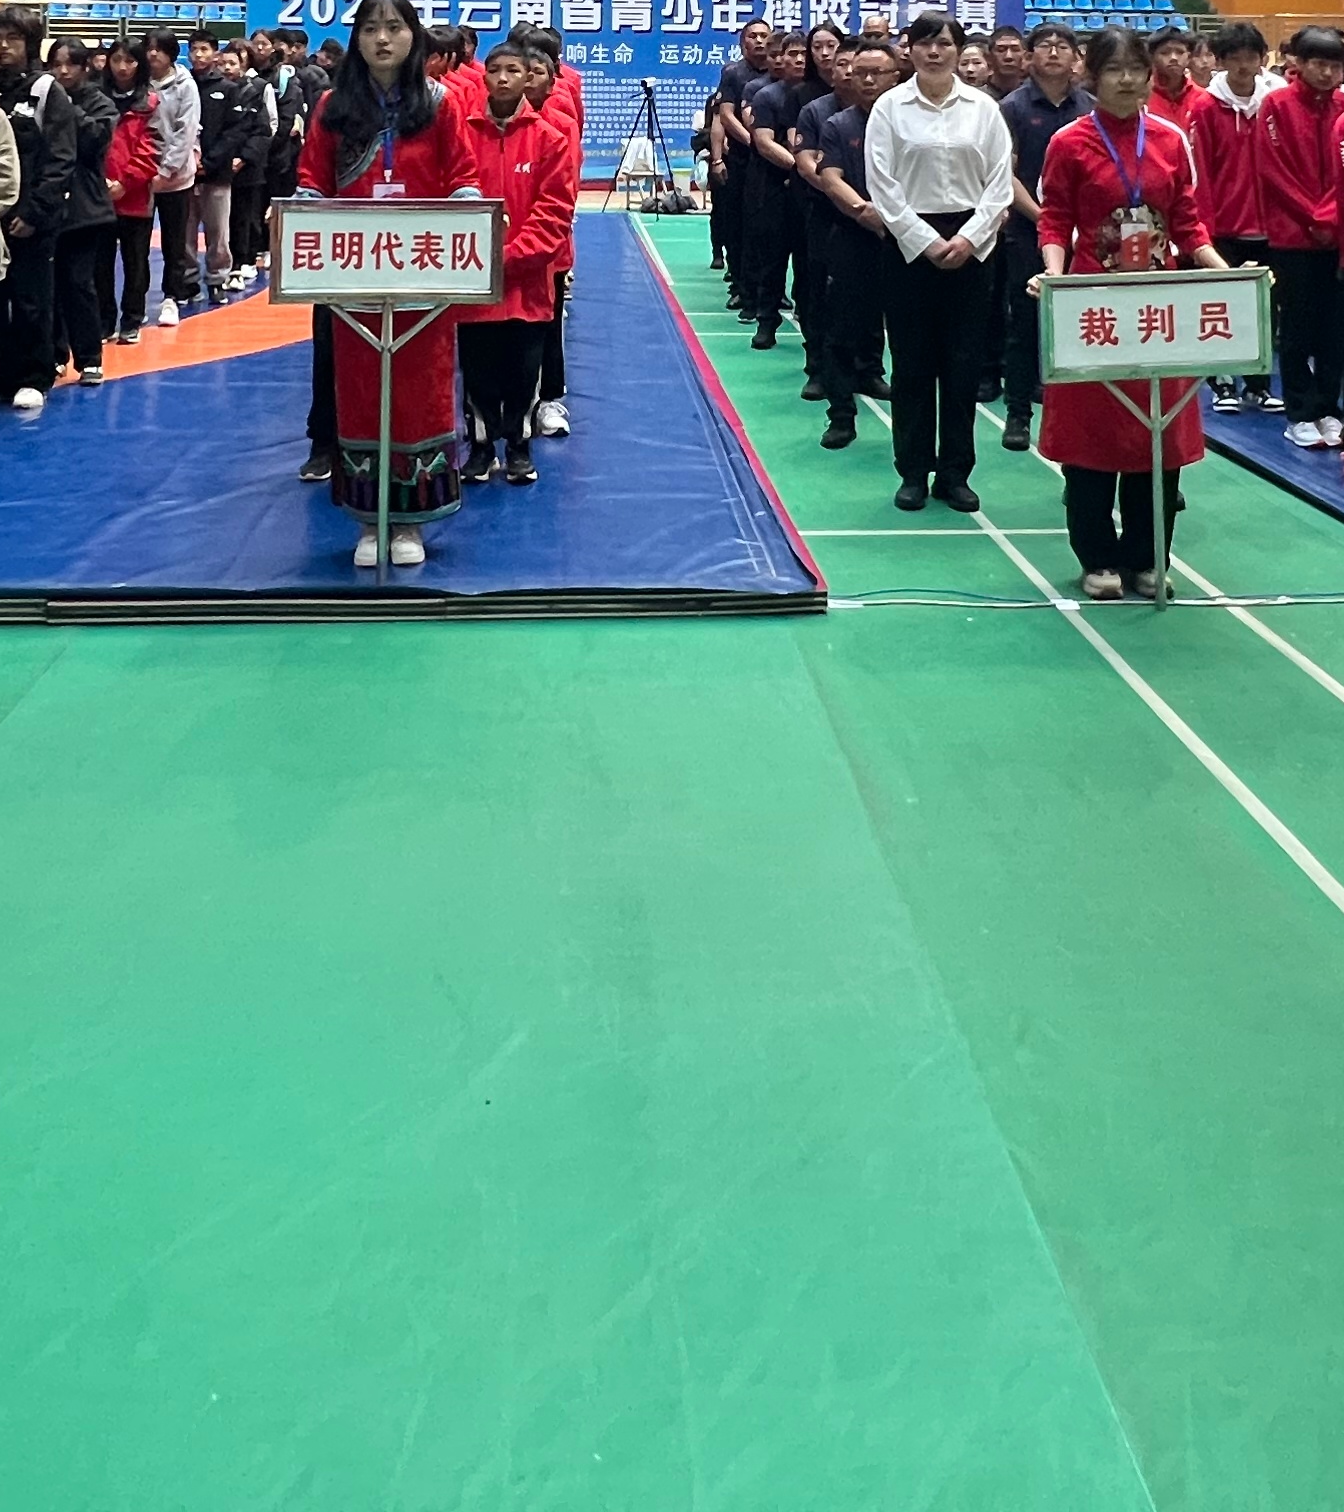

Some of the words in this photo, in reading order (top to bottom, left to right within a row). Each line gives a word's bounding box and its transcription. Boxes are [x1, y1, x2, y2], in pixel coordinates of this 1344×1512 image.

[292, 231, 485, 272] 昆明代表队
[1078, 302, 1234, 347] 裁判员
